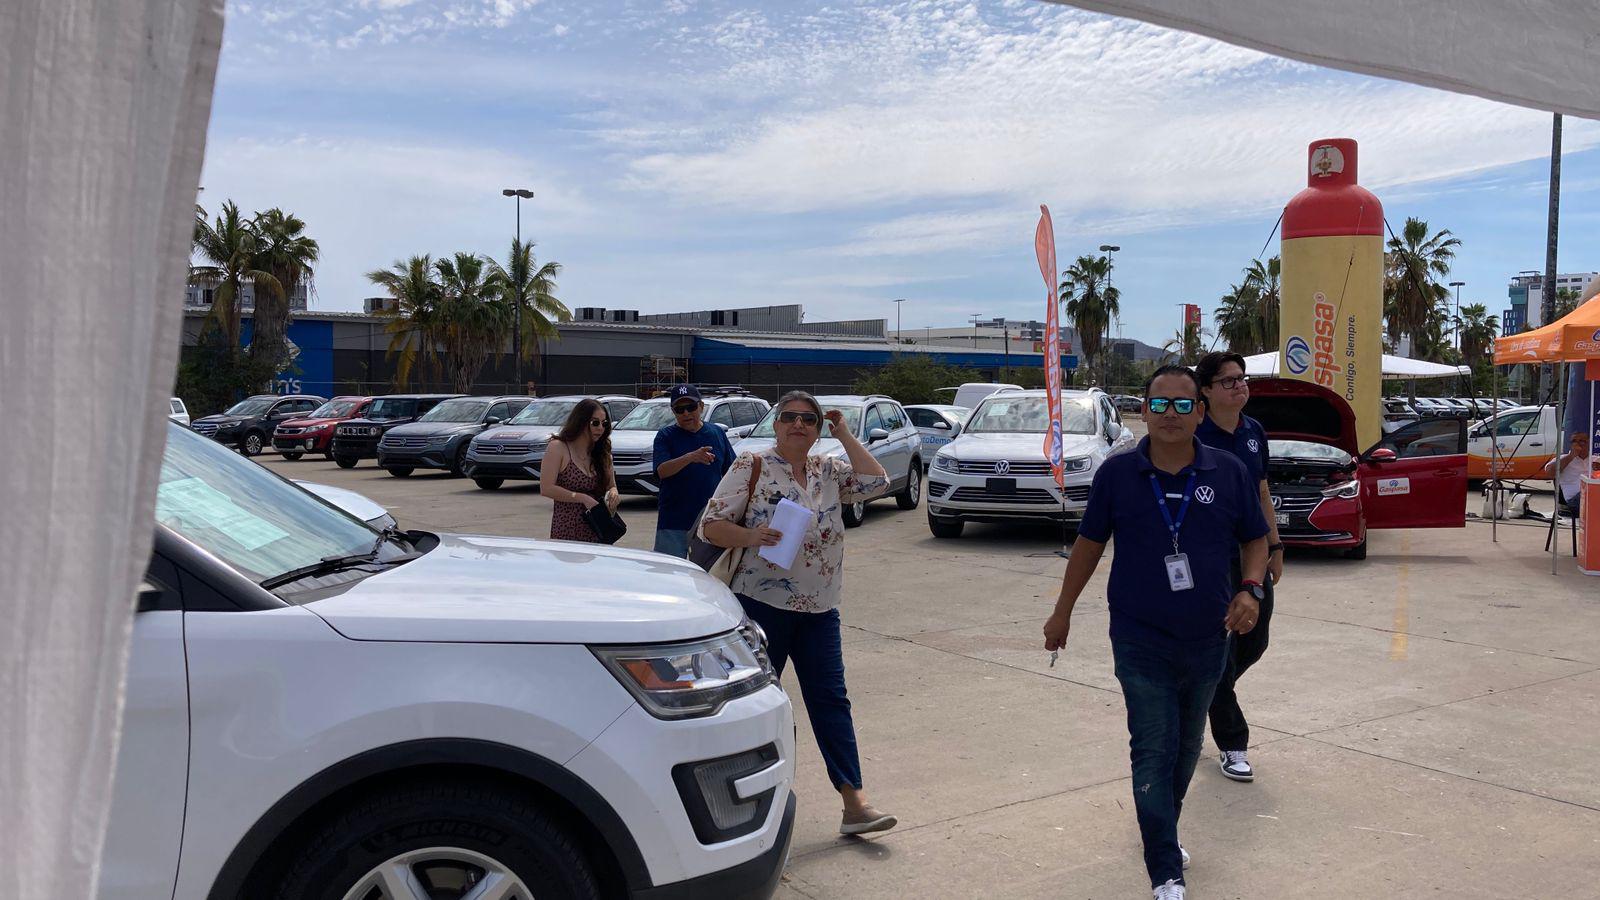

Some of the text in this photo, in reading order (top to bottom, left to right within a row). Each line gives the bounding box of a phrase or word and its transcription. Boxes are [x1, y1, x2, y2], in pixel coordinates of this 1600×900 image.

[1346, 314, 1357, 358] Siempre.
[1574, 340, 1600, 352] Gasp
[921, 436, 952, 445] toDemo
